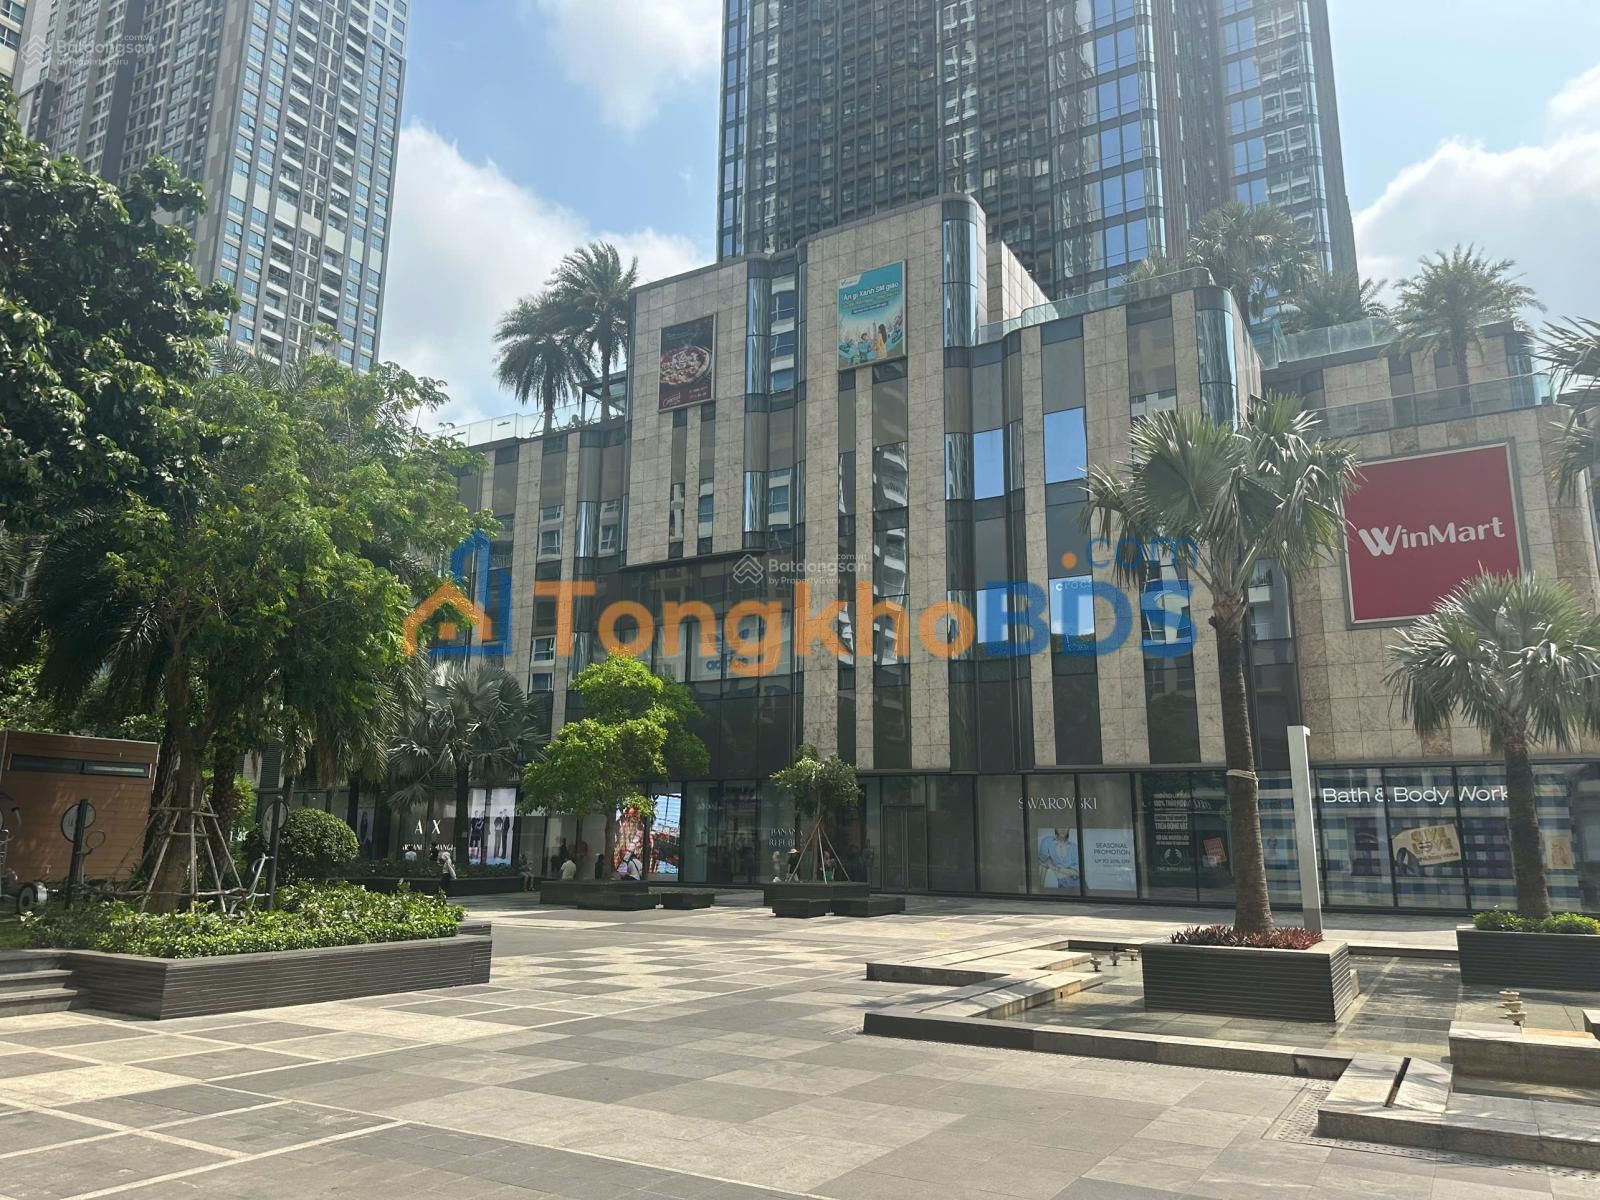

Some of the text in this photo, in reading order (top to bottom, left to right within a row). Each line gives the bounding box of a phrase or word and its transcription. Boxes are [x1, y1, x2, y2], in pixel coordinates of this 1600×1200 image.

[1359, 517, 1505, 557] WinMart
[1018, 797, 1098, 810] SWAROVSKI
[1322, 788, 1370, 803] Bath
[1374, 787, 1391, 803] &
[1394, 786, 1450, 805] Body
